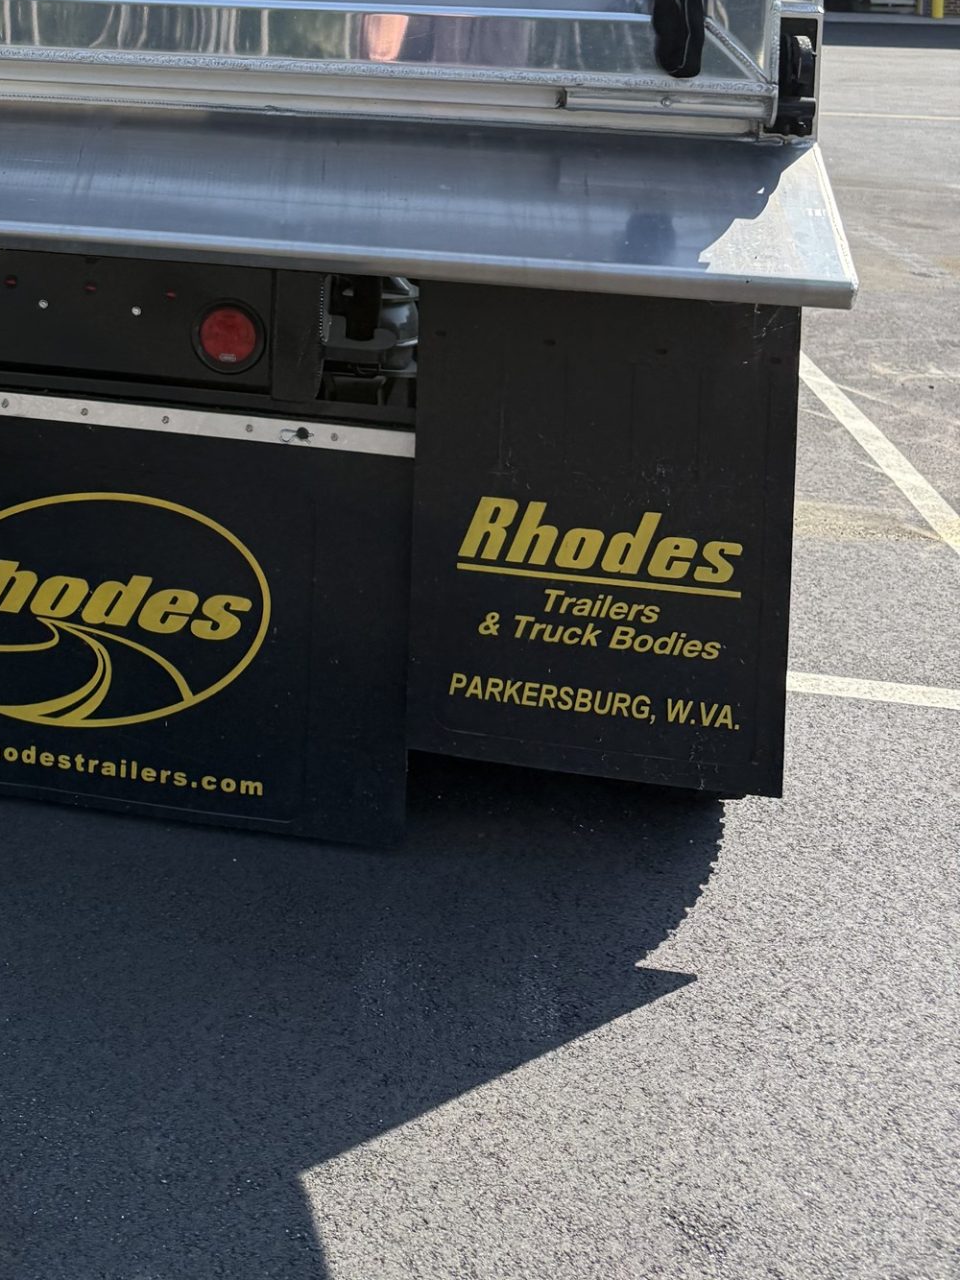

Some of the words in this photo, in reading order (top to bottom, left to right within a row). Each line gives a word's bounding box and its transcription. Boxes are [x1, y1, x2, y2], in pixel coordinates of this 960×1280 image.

[457, 496, 743, 584] Rhodes
[543, 588, 661, 624] Trailers
[478, 611, 500, 637] &
[513, 615, 602, 648] Truck
[608, 626, 721, 660] Bodies
[448, 672, 656, 725] PARKERSBURG,
[666, 698, 740, 731] W.VA.
